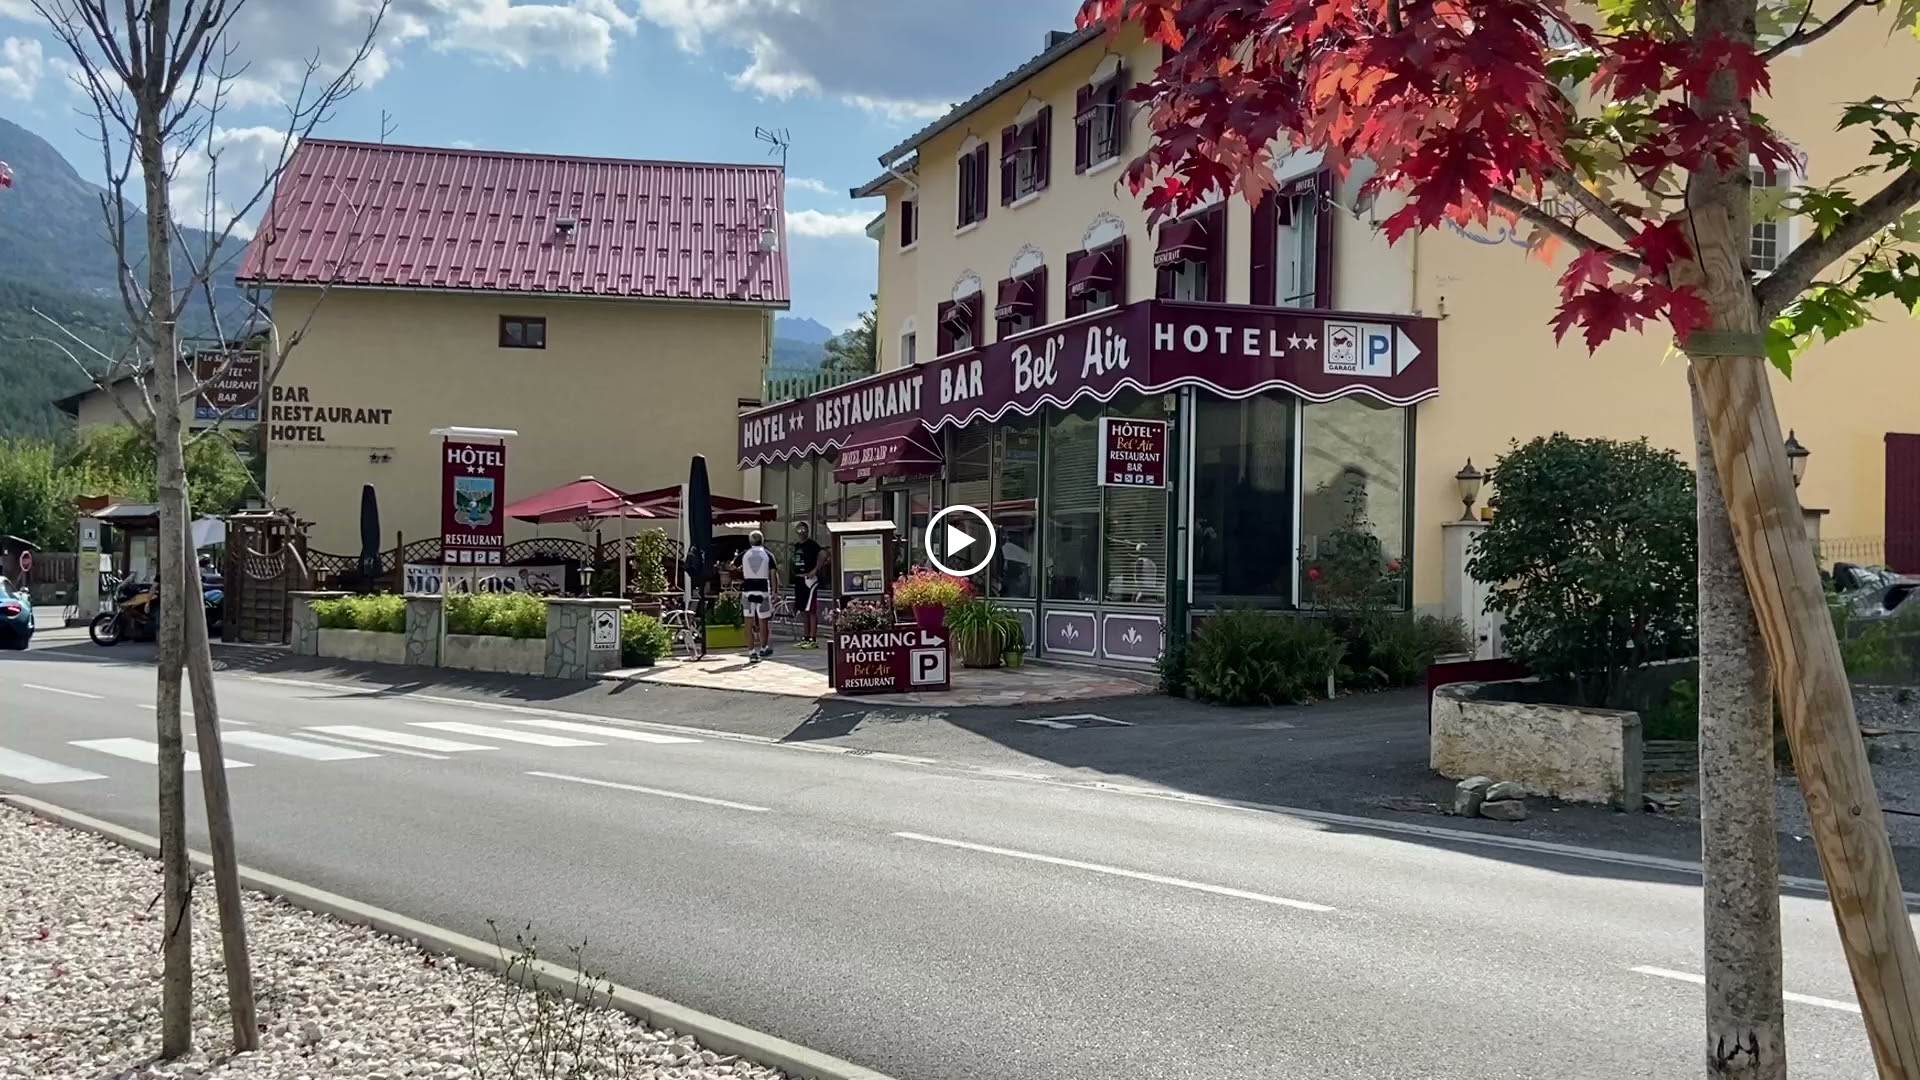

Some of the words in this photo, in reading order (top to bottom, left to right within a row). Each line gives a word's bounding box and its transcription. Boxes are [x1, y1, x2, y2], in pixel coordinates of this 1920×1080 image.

[1155, 323, 1284, 357] HOTEL
[1369, 335, 1389, 365] P
[212, 367, 243, 377] HTEL
[272, 386, 309, 402] BAR
[744, 413, 786, 448] HOTEL
[816, 375, 923, 432] RESTAURANT
[940, 360, 984, 404] BAR
[1081, 326, 1130, 379] Air
[217, 393, 237, 402] BAR
[271, 405, 392, 424] RESTAURANT
[271, 425, 325, 441] HOTEL
[1112, 422, 1152, 438] HÔTEL
[447, 445, 504, 466] HÔTEL
[1110, 450, 1160, 462] RESTAURANT
[1127, 462, 1143, 472] BAR
[445, 534, 502, 546] RESTAURANT
[840, 631, 916, 649] PARKING
[846, 649, 887, 663] HÔTEL
[920, 654, 938, 680] P
[845, 677, 895, 688] RESTAURANT
